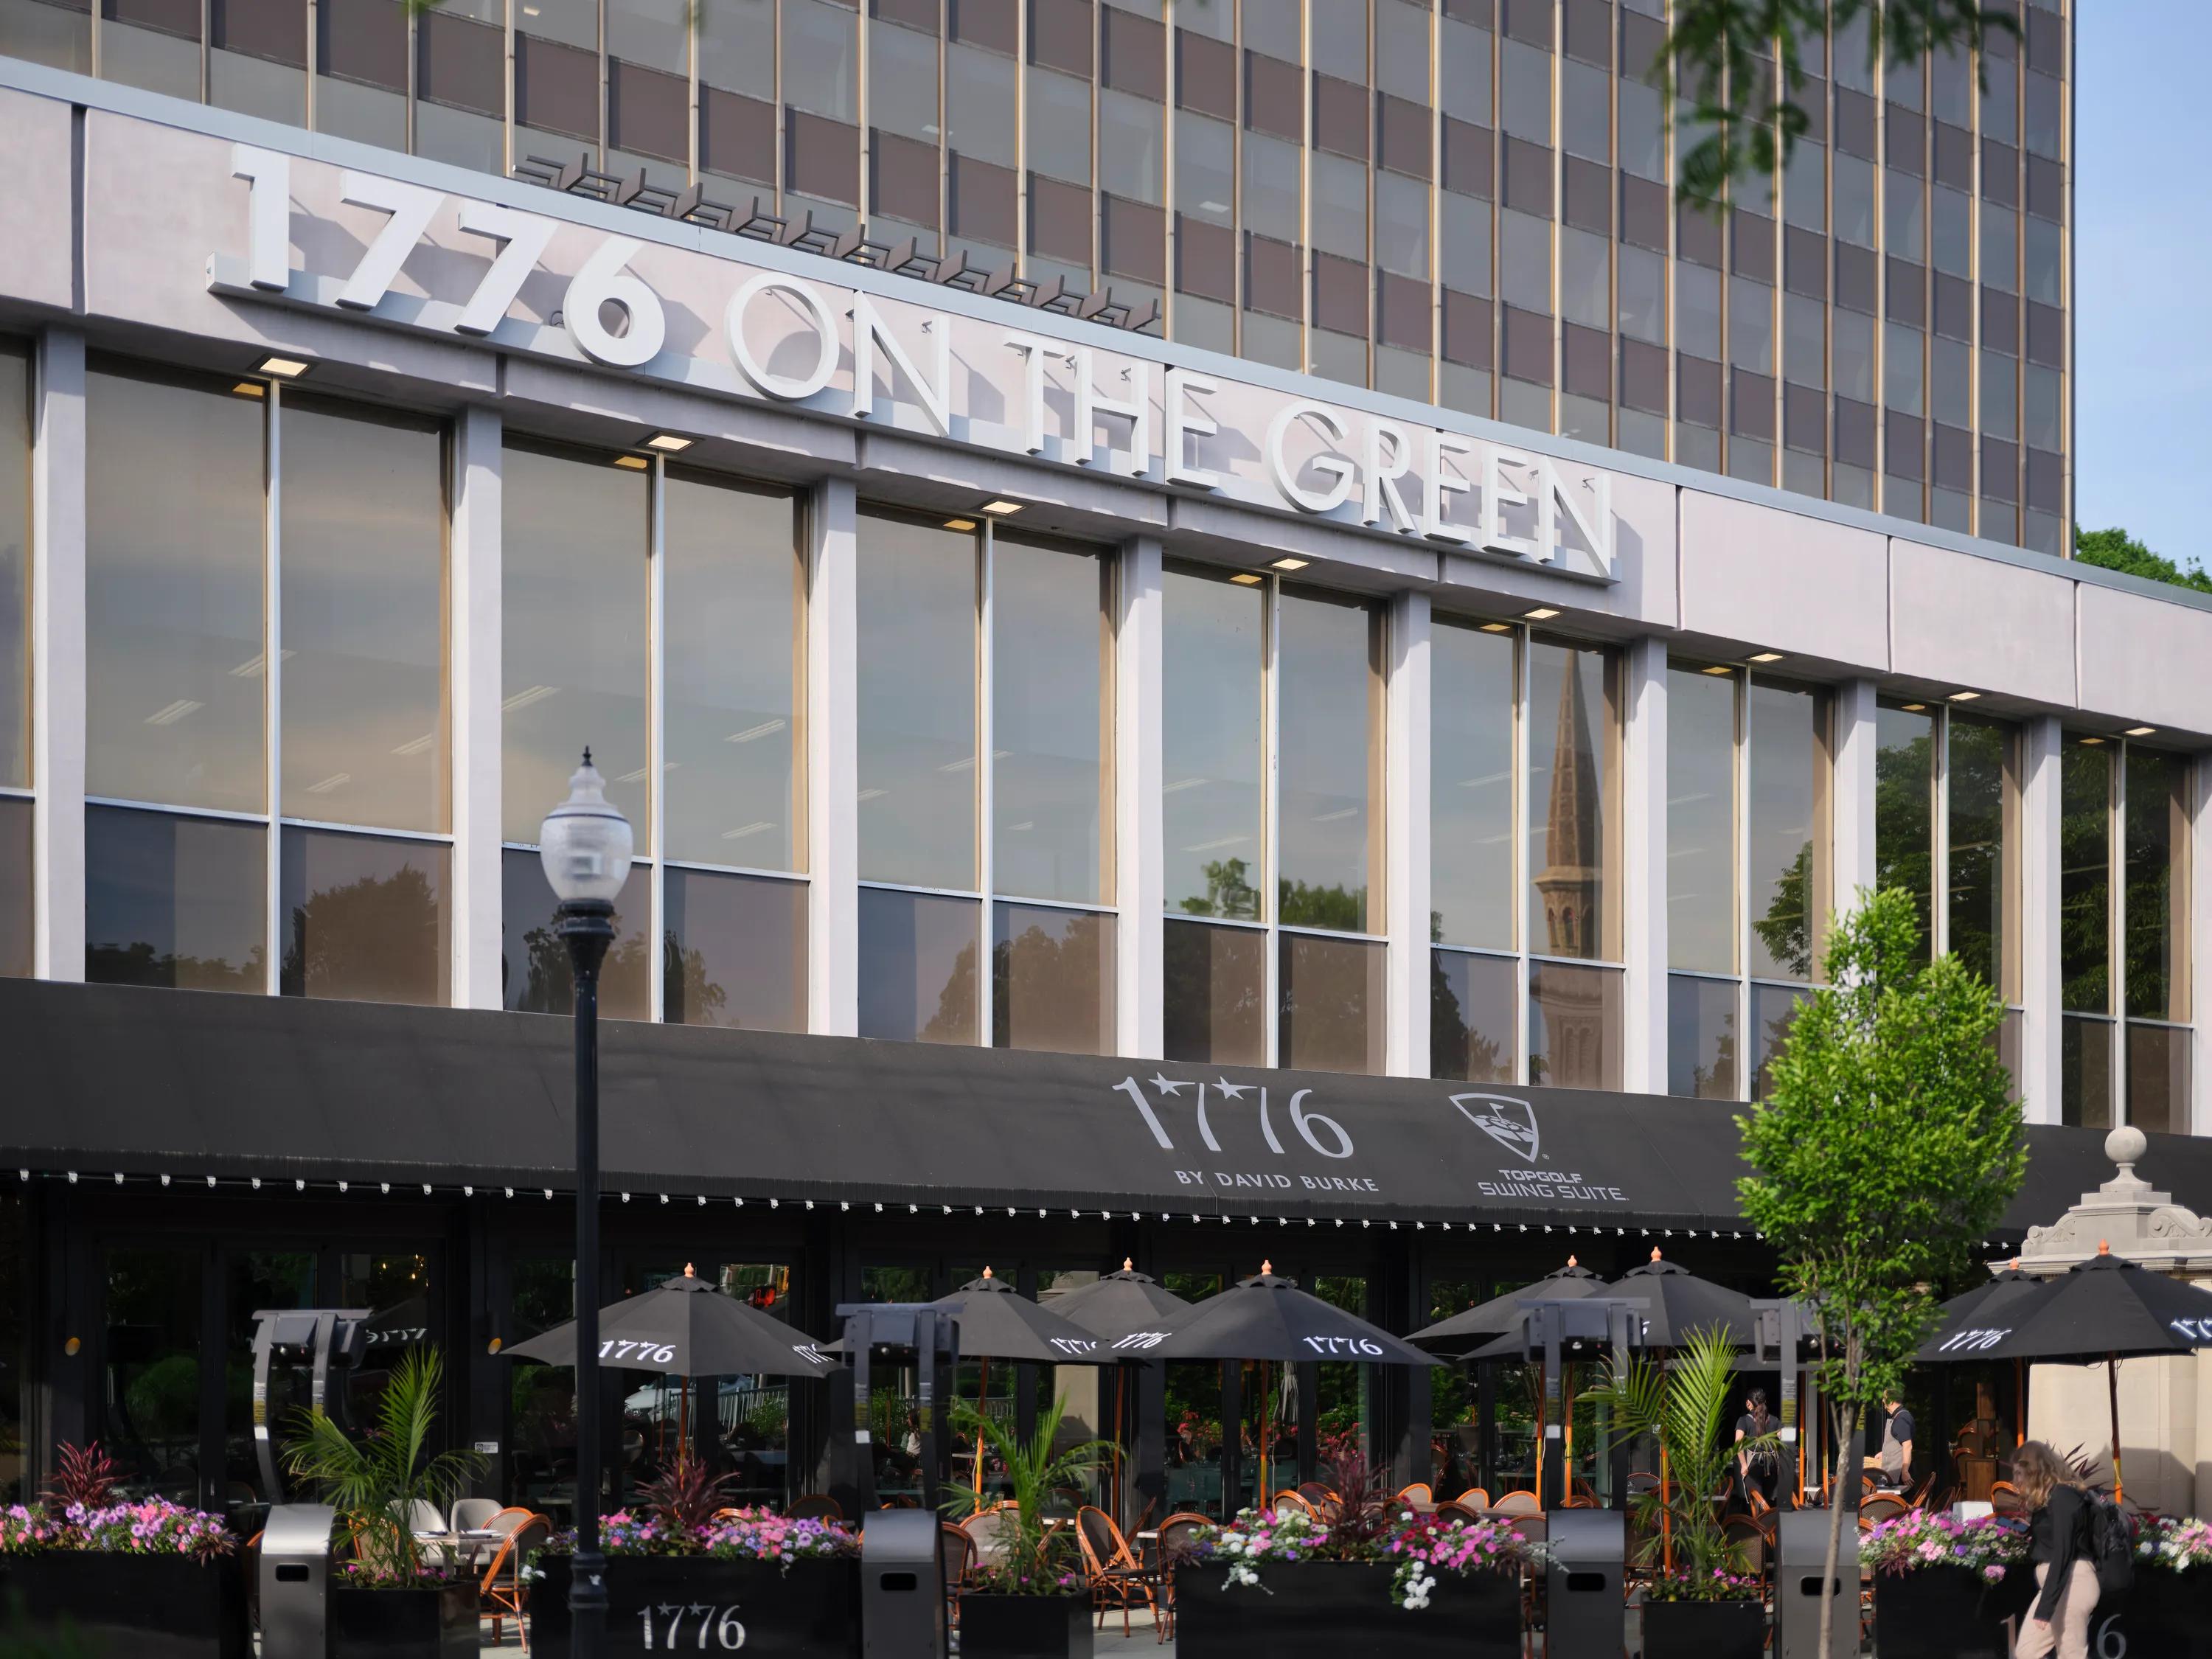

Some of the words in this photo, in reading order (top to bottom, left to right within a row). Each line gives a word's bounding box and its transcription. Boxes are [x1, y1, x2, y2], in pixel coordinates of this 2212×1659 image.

[231, 142, 666, 368] 1776
[724, 272, 950, 438] ON
[1004, 330, 1219, 490] THE
[1266, 399, 1611, 577] GREEN
[1112, 1071, 1354, 1158] 1776
[1174, 1170, 1204, 1185] BY
[1214, 1172, 1292, 1189] DAVID
[1299, 1175, 1380, 1192] BURKE
[1498, 1169, 1583, 1184] TOPGOLF
[1478, 1182, 1555, 1198] SWING
[598, 1339, 676, 1363] 1776
[1111, 1332, 1172, 1349] 1776
[1303, 1335, 1383, 1355] 1776
[1938, 1327, 2012, 1352] 1776
[637, 1601, 746, 1649] 1776
